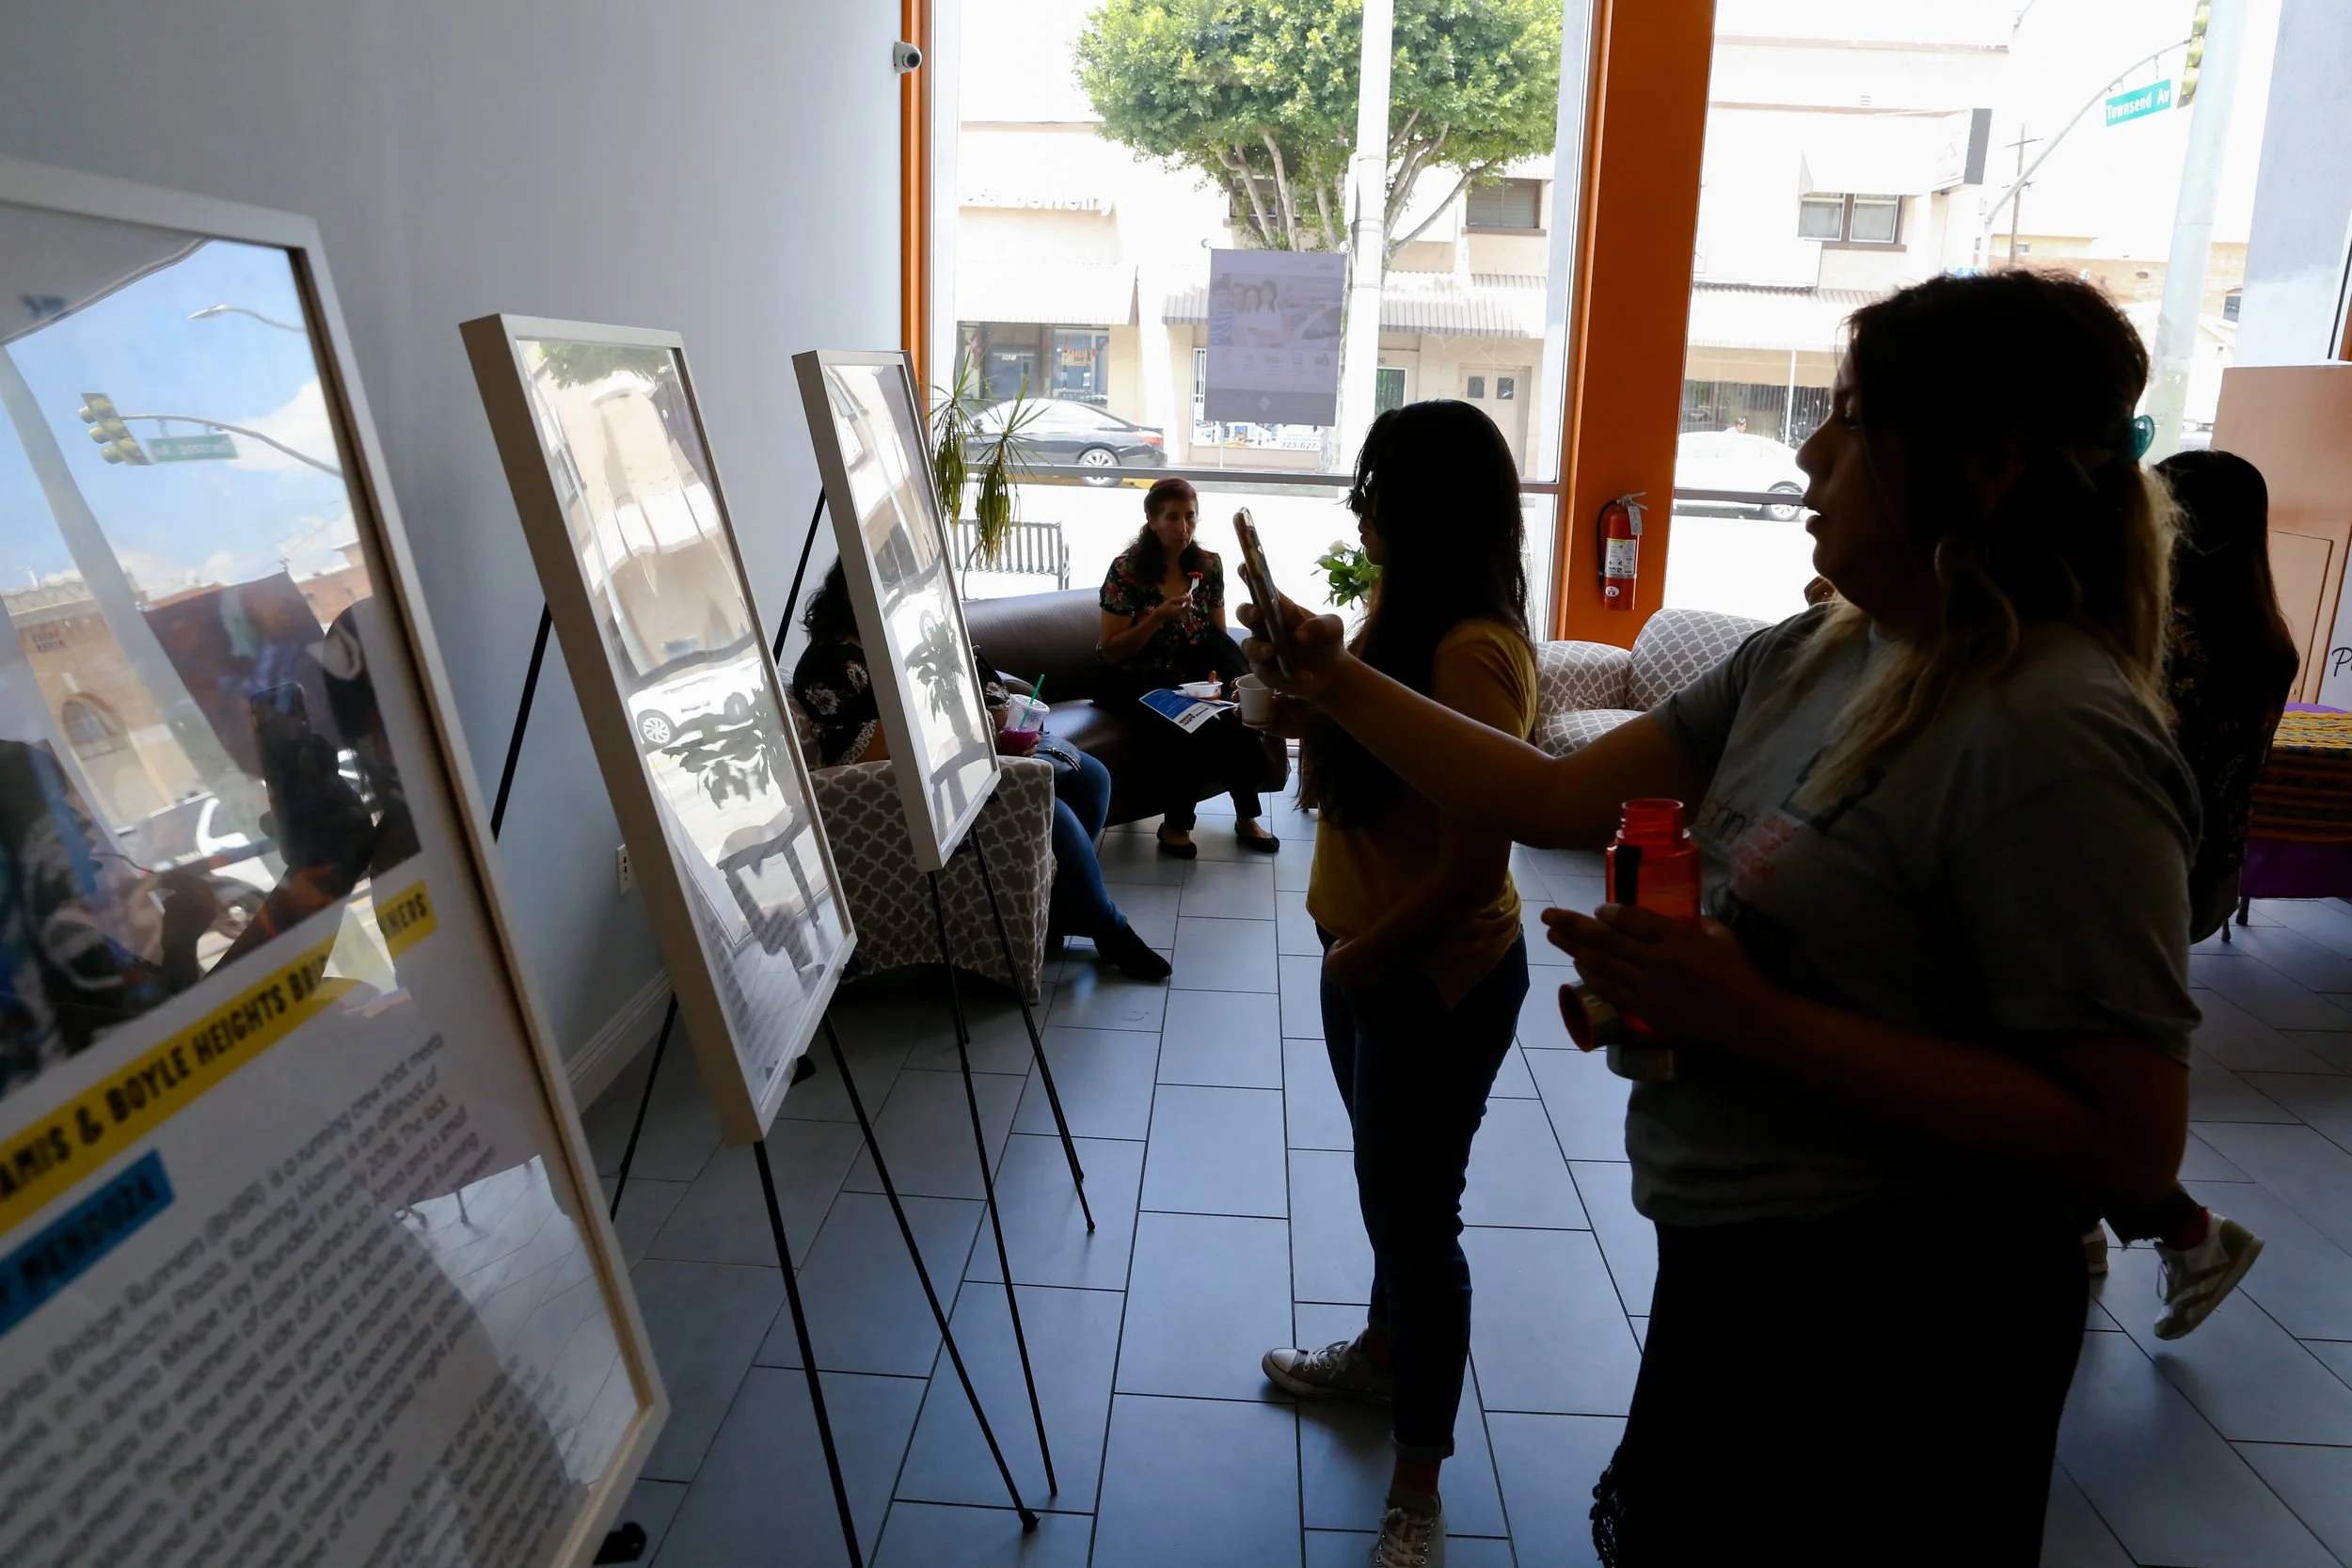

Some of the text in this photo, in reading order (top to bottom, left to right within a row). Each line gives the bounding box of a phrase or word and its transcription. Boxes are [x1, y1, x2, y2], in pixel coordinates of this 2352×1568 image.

[2107, 87, 2170, 120] Townsend Av
[2331, 646, 2352, 677] P
[69, 1101, 106, 1150] &
[102, 1043, 192, 1127] BOYLE
[189, 979, 289, 1068] HEIGHTS
